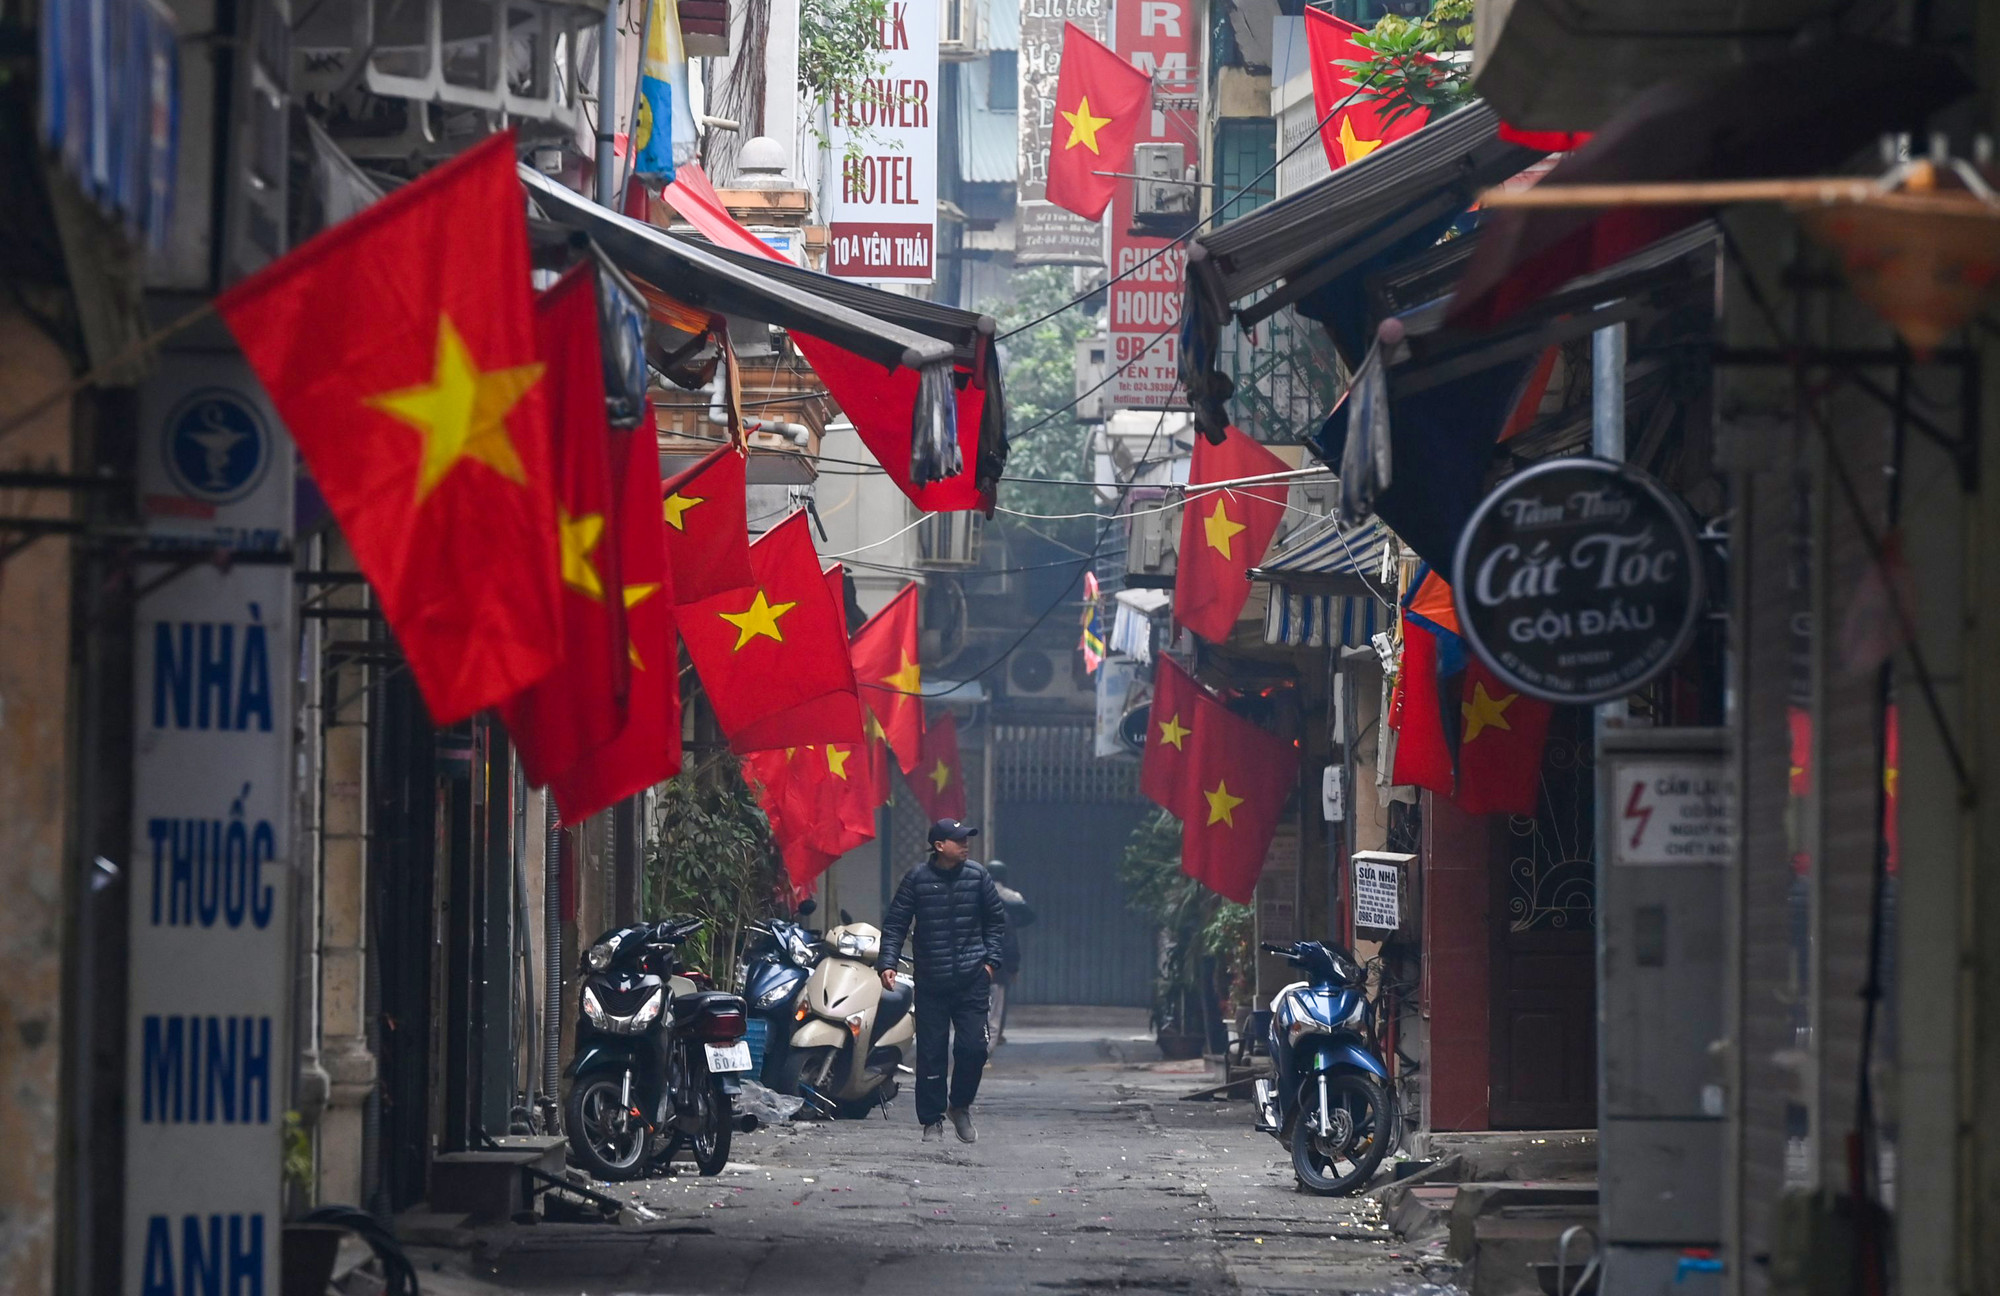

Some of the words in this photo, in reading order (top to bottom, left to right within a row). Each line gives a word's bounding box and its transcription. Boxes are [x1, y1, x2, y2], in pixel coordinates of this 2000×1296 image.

[833, 78, 929, 128] FLOWER
[843, 153, 919, 205] HOTEL
[862, 231, 892, 267] YÊN
[894, 231, 928, 267] THÁI
[1116, 336, 1146, 361] 9B
[1154, 366, 1176, 379] TH
[1474, 540, 1566, 606] Cắt
[1571, 524, 1677, 589] Tóc
[154, 602, 273, 732] NHÀ
[148, 782, 275, 928] THUỐC
[1378, 869, 1396, 884] NHÀ
[142, 1015, 271, 1124] MINH
[141, 1213, 266, 1296] ANH
